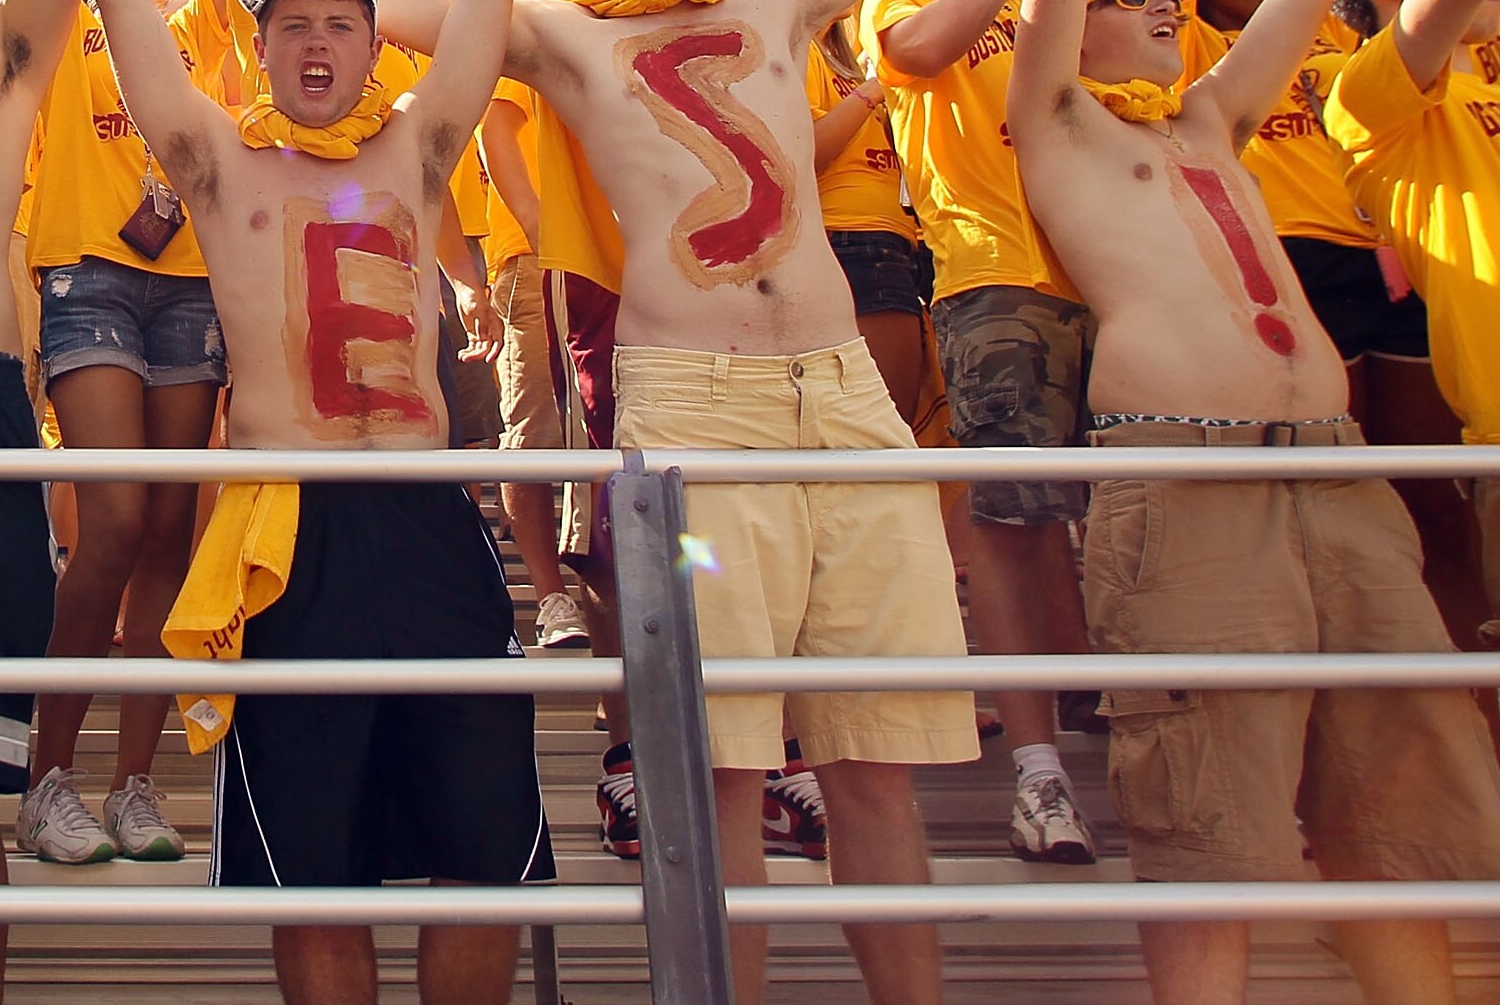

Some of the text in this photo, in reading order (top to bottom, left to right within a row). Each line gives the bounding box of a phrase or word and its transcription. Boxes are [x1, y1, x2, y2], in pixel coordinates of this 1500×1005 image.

[633, 31, 785, 268] S
[304, 221, 431, 419] E
[1178, 163, 1296, 356] !
